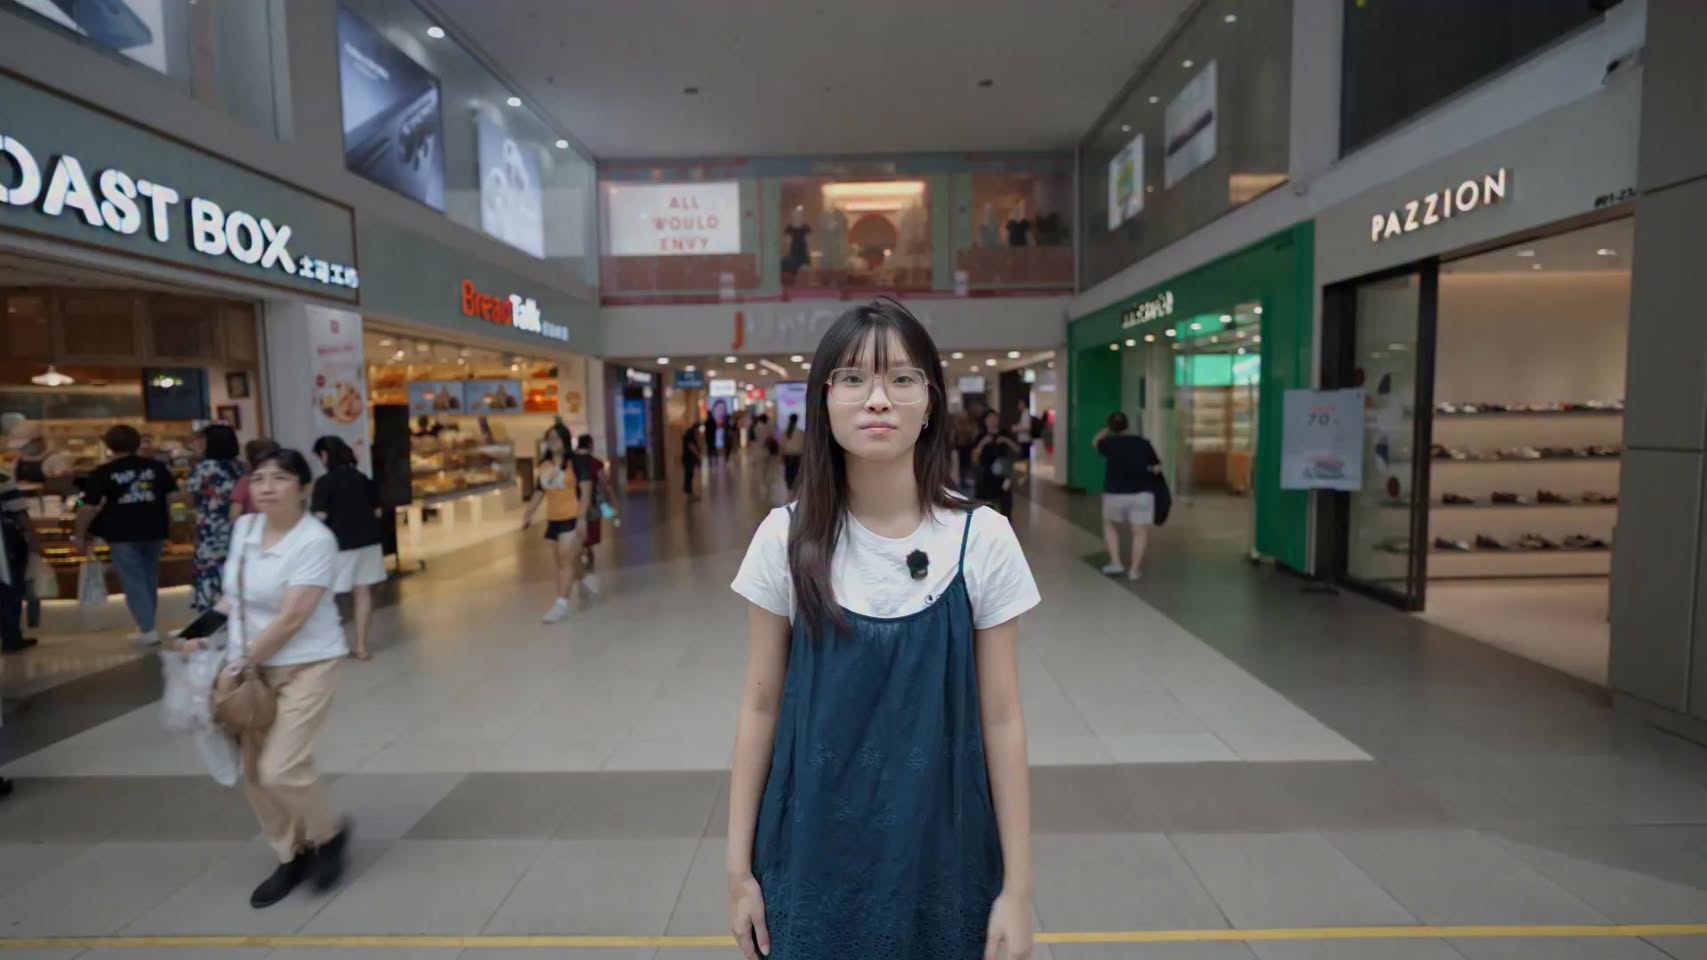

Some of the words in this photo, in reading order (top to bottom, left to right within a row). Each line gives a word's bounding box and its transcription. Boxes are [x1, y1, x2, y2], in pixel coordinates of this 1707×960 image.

[668, 196, 699, 209] ALL
[1371, 167, 1506, 241] PAZZION
[654, 215, 720, 230] WOULD
[191, 197, 296, 274] BOX
[660, 237, 709, 250] ENVY
